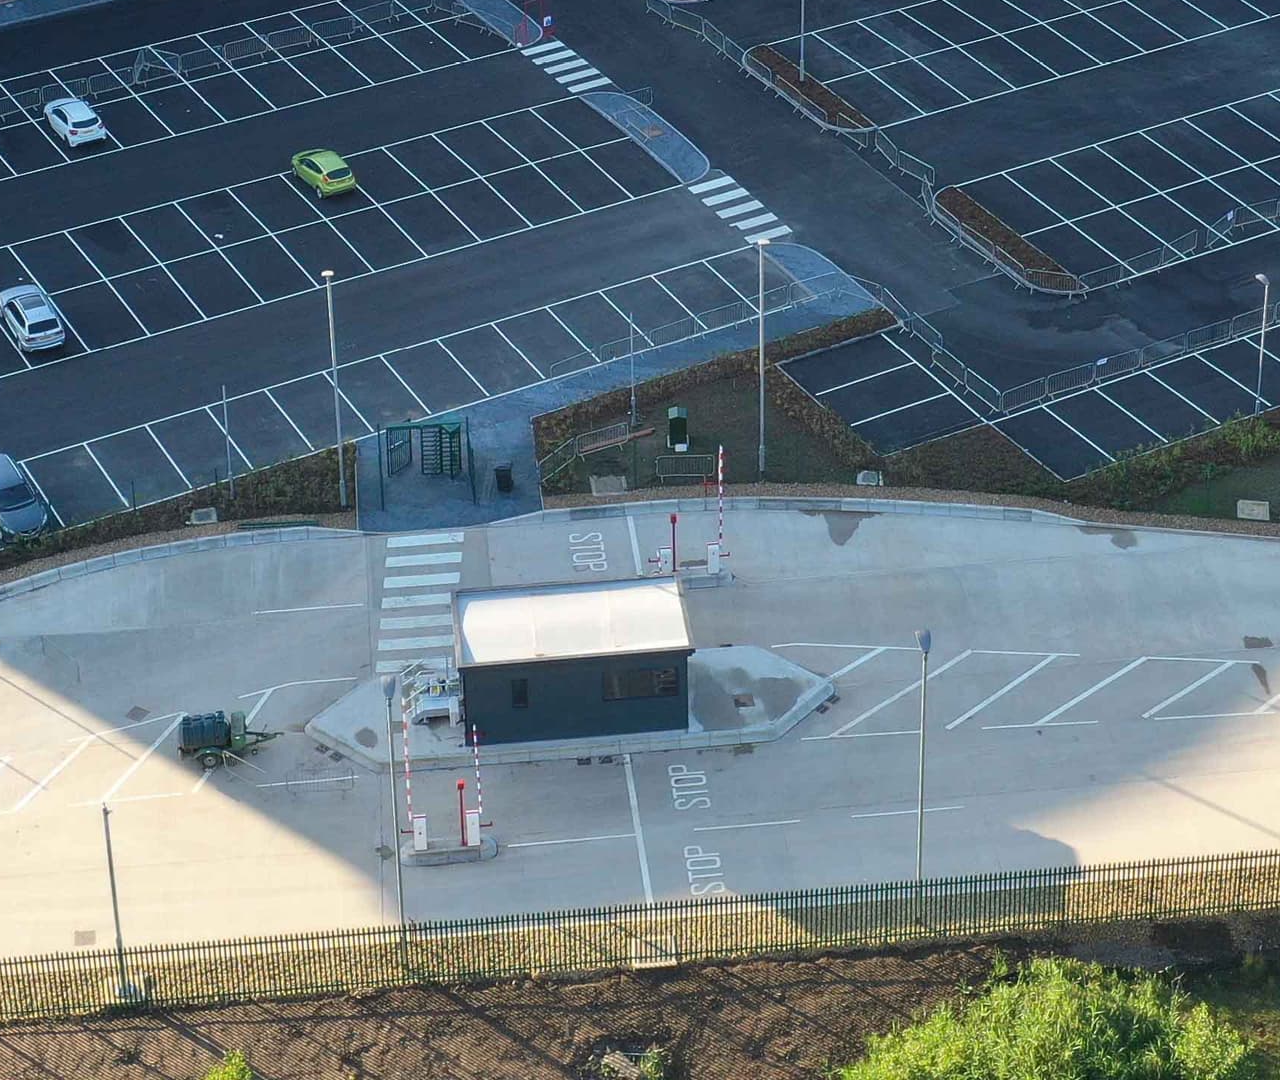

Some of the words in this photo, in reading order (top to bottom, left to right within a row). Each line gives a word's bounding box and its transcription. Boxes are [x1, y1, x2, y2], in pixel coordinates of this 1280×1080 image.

[568, 532, 608, 572] STOP
[667, 764, 711, 810] STOP
[683, 845, 726, 896] STOP
